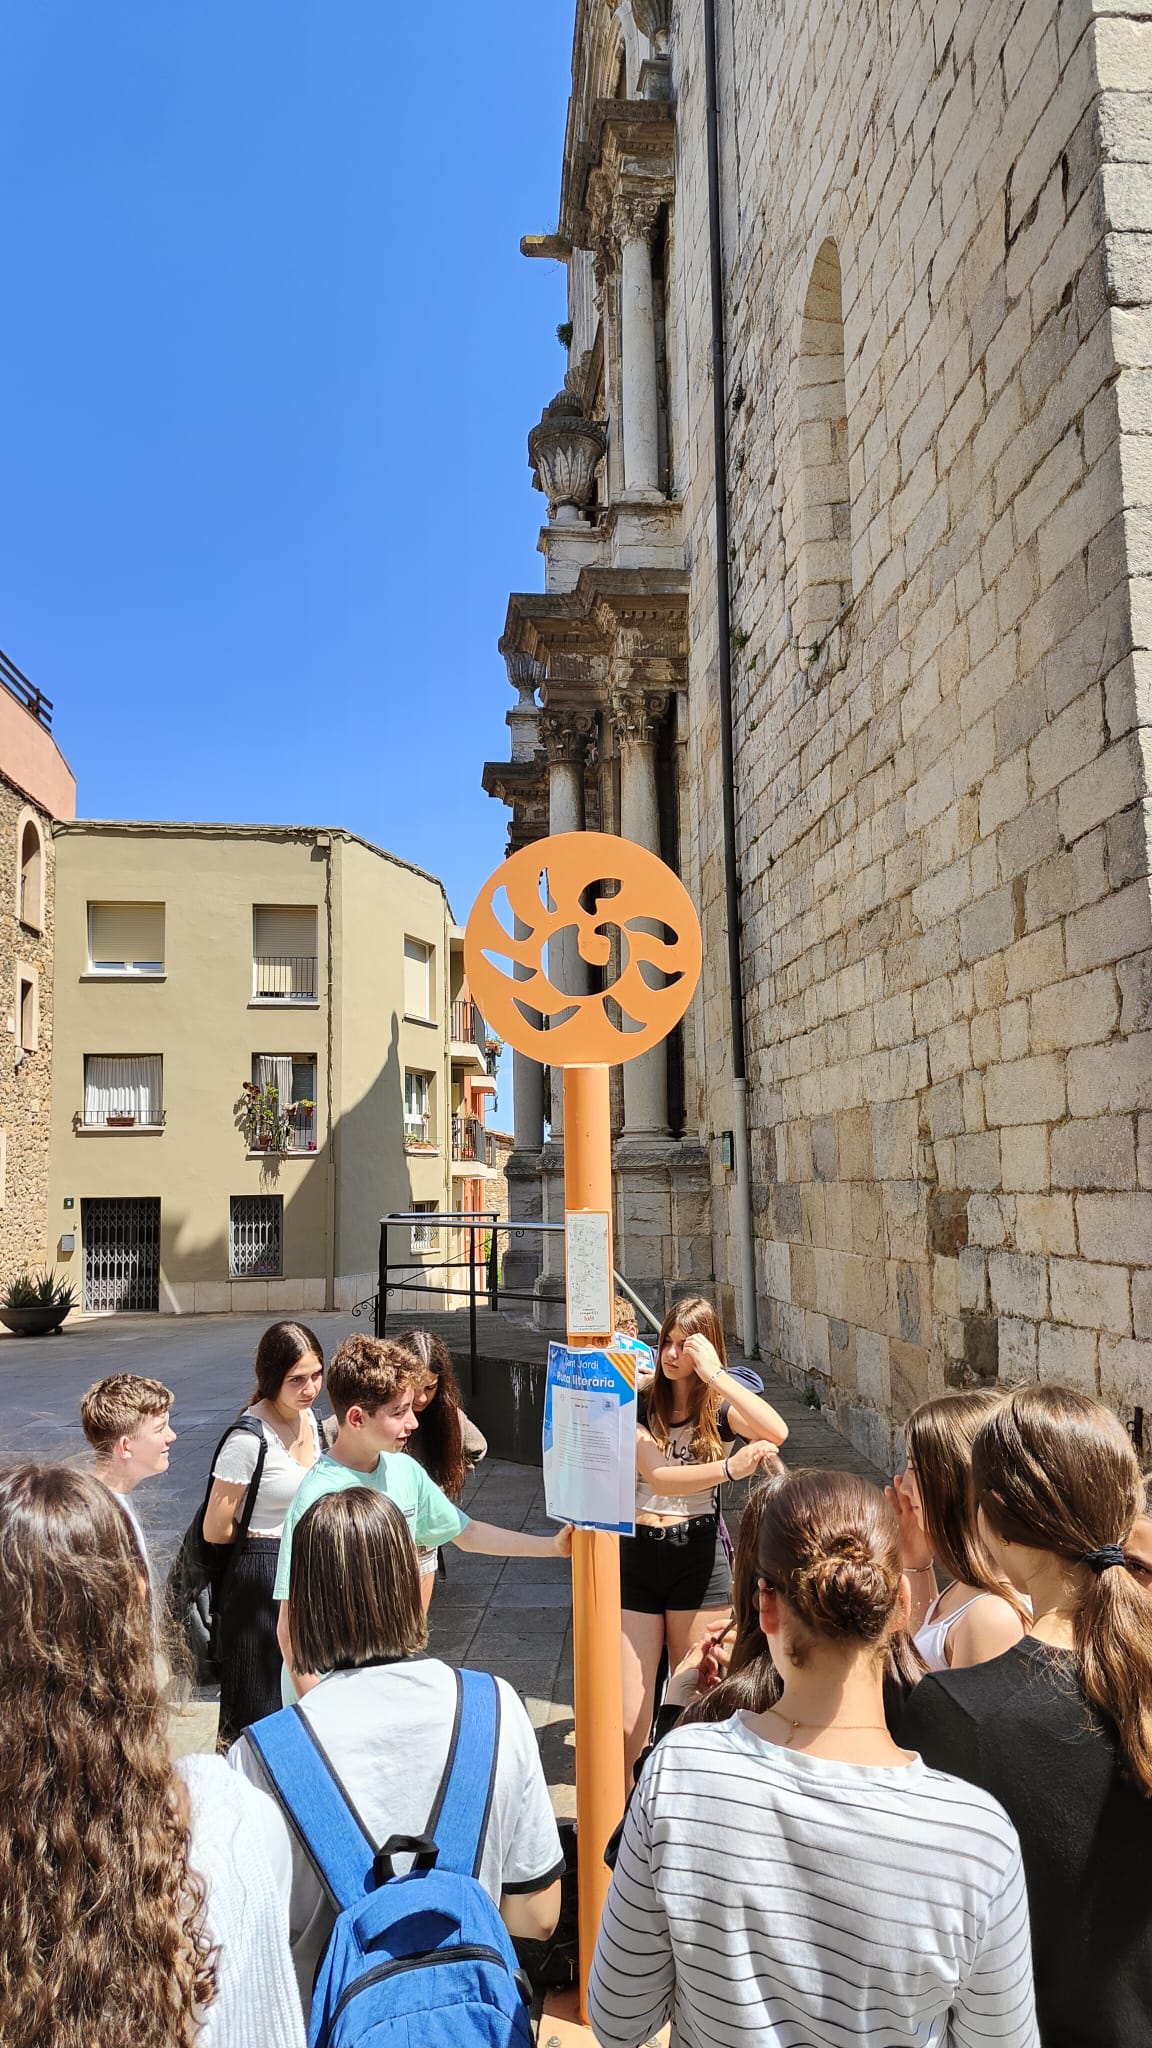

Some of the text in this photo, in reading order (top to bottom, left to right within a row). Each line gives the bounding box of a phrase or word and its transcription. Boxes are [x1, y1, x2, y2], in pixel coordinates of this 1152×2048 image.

[564, 1356, 599, 1369] Sant Jordi
[557, 1371, 615, 1388] Ruta literària
